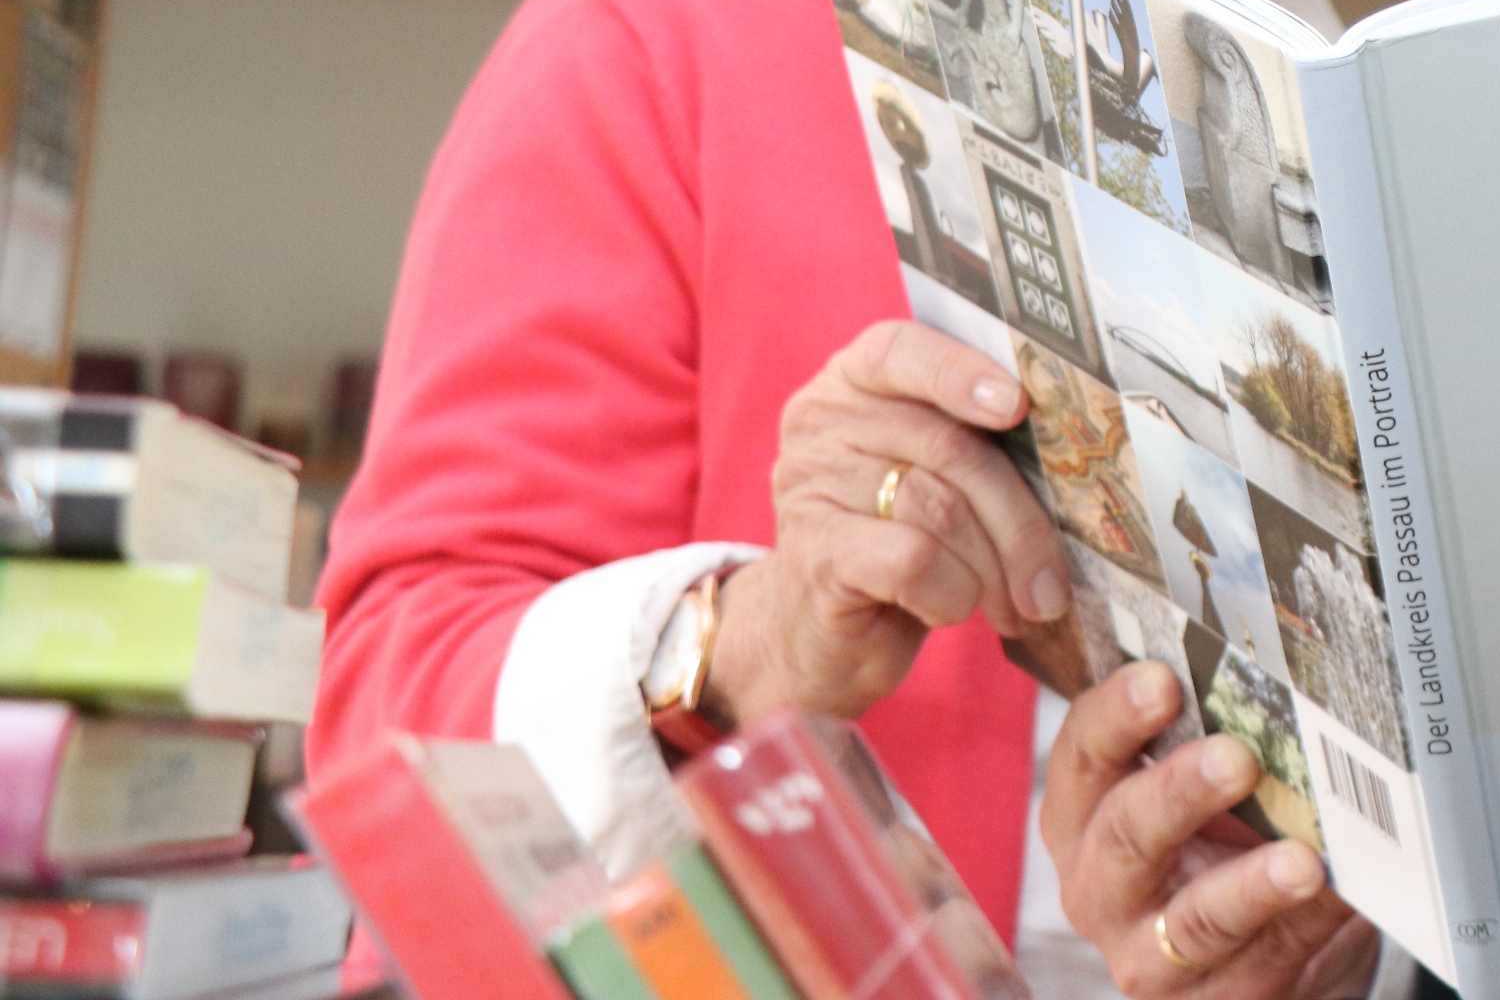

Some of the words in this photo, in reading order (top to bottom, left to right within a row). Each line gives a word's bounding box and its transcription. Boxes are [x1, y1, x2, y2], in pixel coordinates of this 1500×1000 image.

[1360, 347, 1400, 449] Portrait
[1381, 456, 1407, 489] im
[1390, 495, 1423, 584] Passau
[1402, 590, 1444, 707] Landkreis
[1428, 713, 1453, 756] Der
